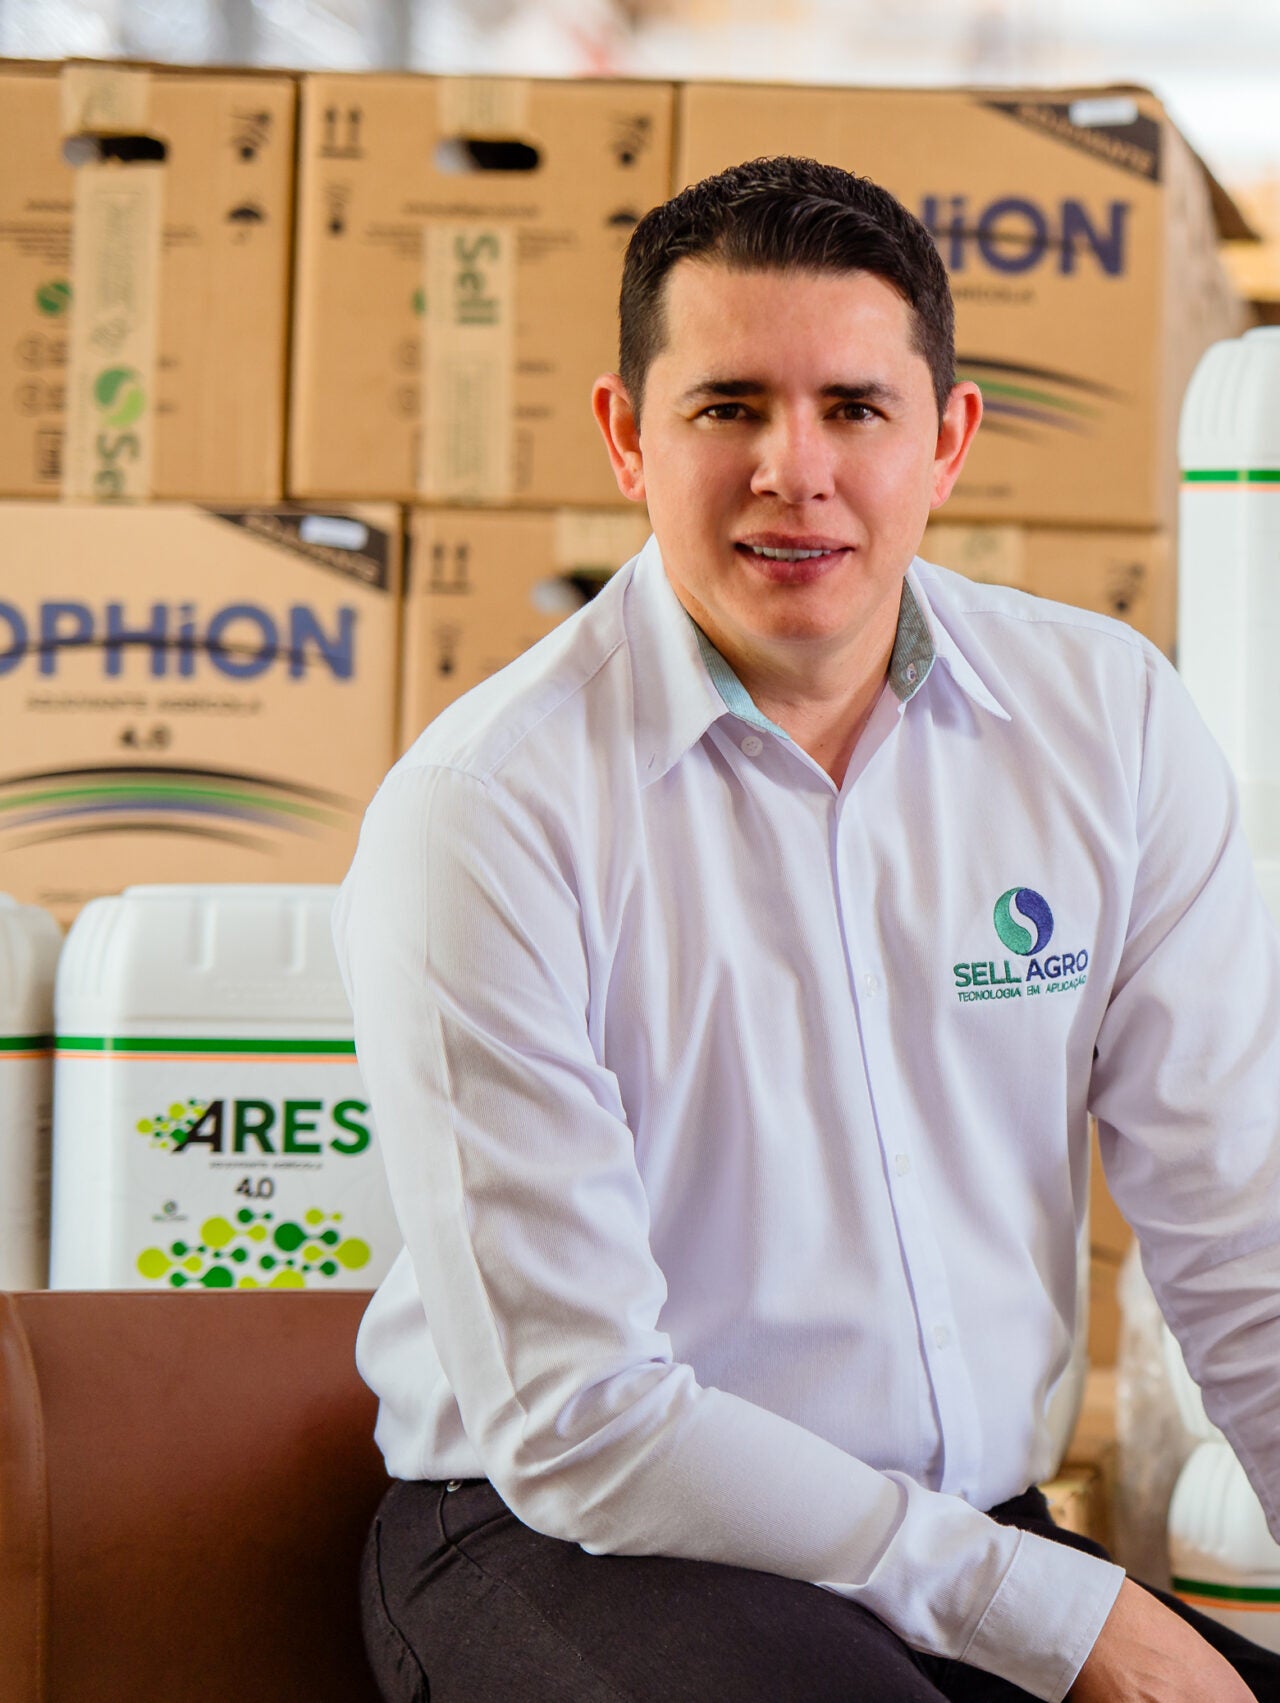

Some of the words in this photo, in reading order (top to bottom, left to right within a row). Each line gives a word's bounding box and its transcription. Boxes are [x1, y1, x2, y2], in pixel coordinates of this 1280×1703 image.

[455, 233, 499, 325] Sell
[953, 960, 1022, 988] SELL
[1025, 949, 1089, 982] AGRO
[958, 987, 1022, 1003] TECNOLOGIA
[1026, 985, 1041, 996] EM
[1045, 974, 1087, 994] APLICAÇÃO
[172, 1099, 372, 1155] ARES
[235, 1176, 275, 1200] 4.0
